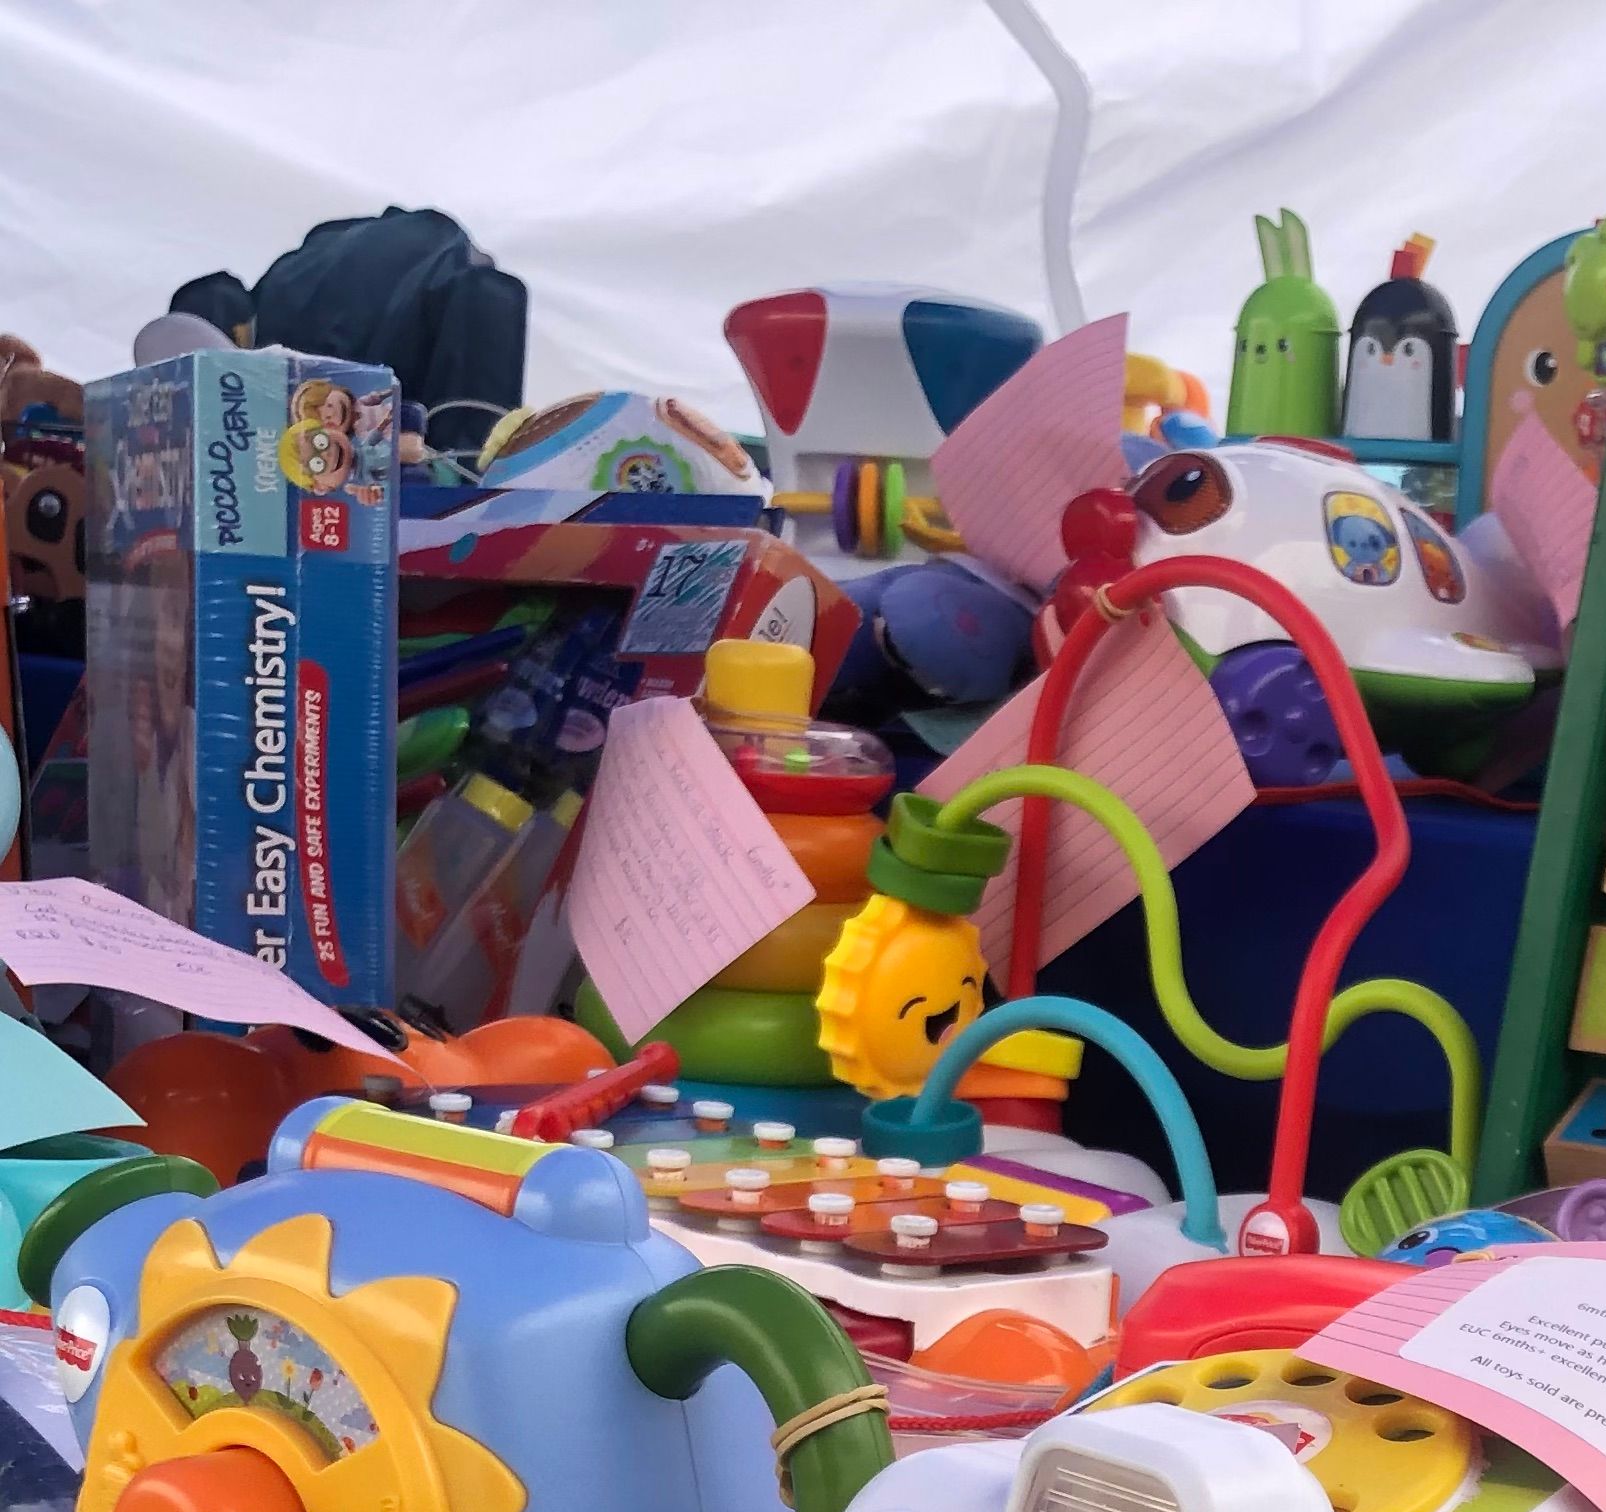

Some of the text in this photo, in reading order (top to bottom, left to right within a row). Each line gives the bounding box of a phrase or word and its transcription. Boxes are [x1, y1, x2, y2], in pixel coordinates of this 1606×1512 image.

[208, 370, 257, 547] PICCOLO GENIO
[308, 506, 326, 544] Ages
[322, 505, 341, 547] 8-12
[646, 554, 707, 598] 17
[244, 584, 297, 816] Chemistry!
[303, 689, 336, 962] 25 FUN AND SAFE EXPERIMENTS
[246, 826, 297, 917] Easy
[1458, 1323, 1491, 1337] EUC
[1492, 1331, 1546, 1356] 6mths+
[1499, 1320, 1531, 1336] Eyes
[1534, 1331, 1575, 1352] move
[1577, 1345, 1593, 1359] as
[1528, 1315, 1591, 1343] Excellent
[1470, 1355, 1492, 1369] All
[1494, 1362, 1524, 1383] toys
[1527, 1376, 1560, 1397] sold
[1560, 1393, 1585, 1411] are
